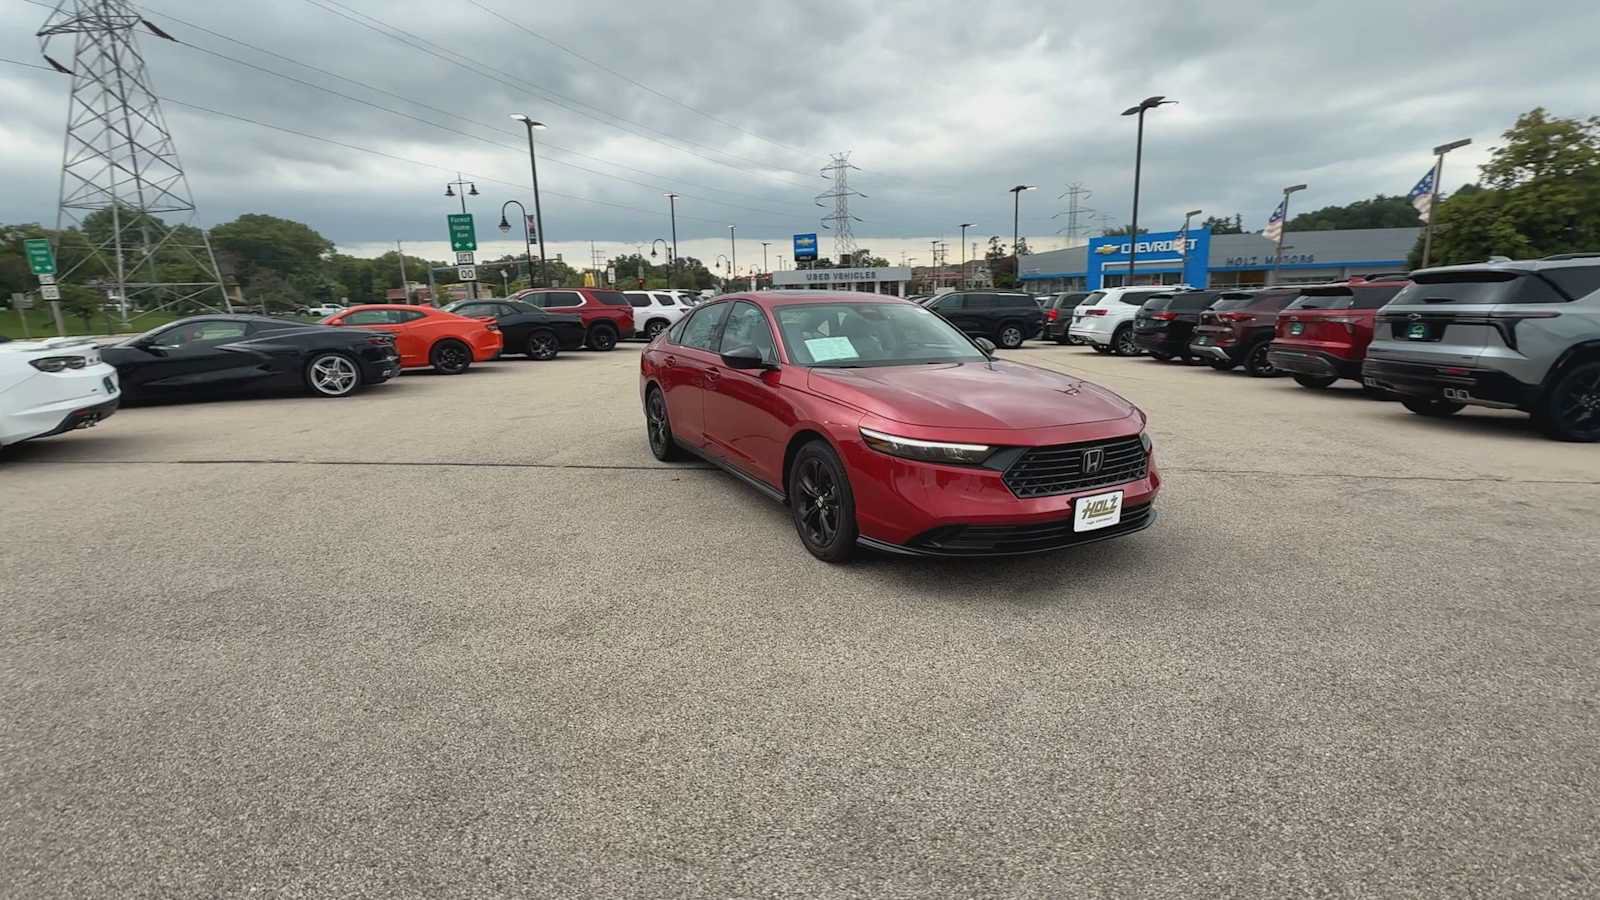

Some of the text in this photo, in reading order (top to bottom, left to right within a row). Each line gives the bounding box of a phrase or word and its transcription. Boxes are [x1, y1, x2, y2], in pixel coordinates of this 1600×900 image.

[1121, 239, 1198, 254] CHEVROT
[806, 271, 876, 281] USED VEHICLES
[1082, 495, 1118, 519] HOLZ
